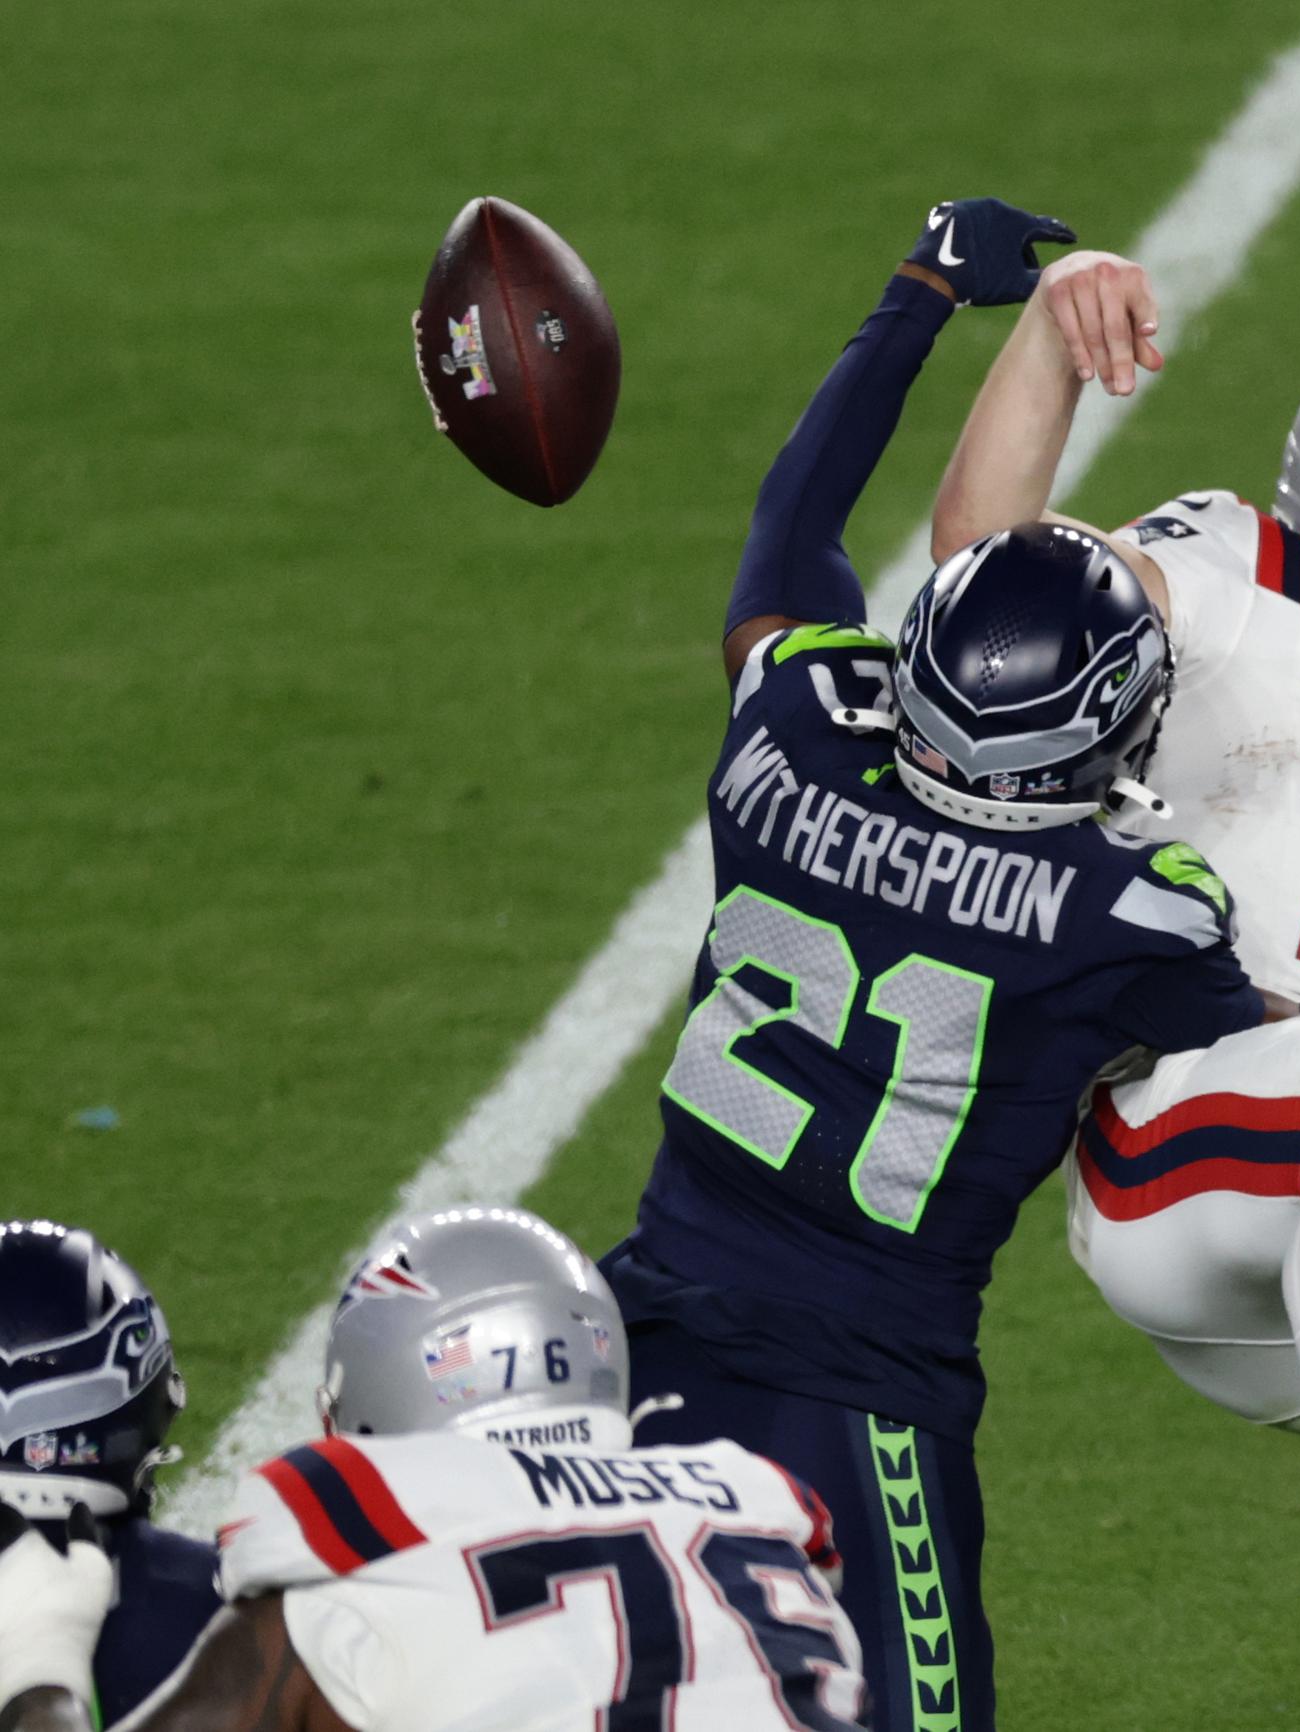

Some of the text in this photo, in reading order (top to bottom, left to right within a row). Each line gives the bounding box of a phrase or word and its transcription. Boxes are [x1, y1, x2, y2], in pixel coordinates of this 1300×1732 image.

[716, 726, 1077, 945] WITHERSPOON
[911, 779, 1041, 824] SEATTLE
[660, 882, 995, 1235] 21
[508, 1448, 742, 1514] MOSES
